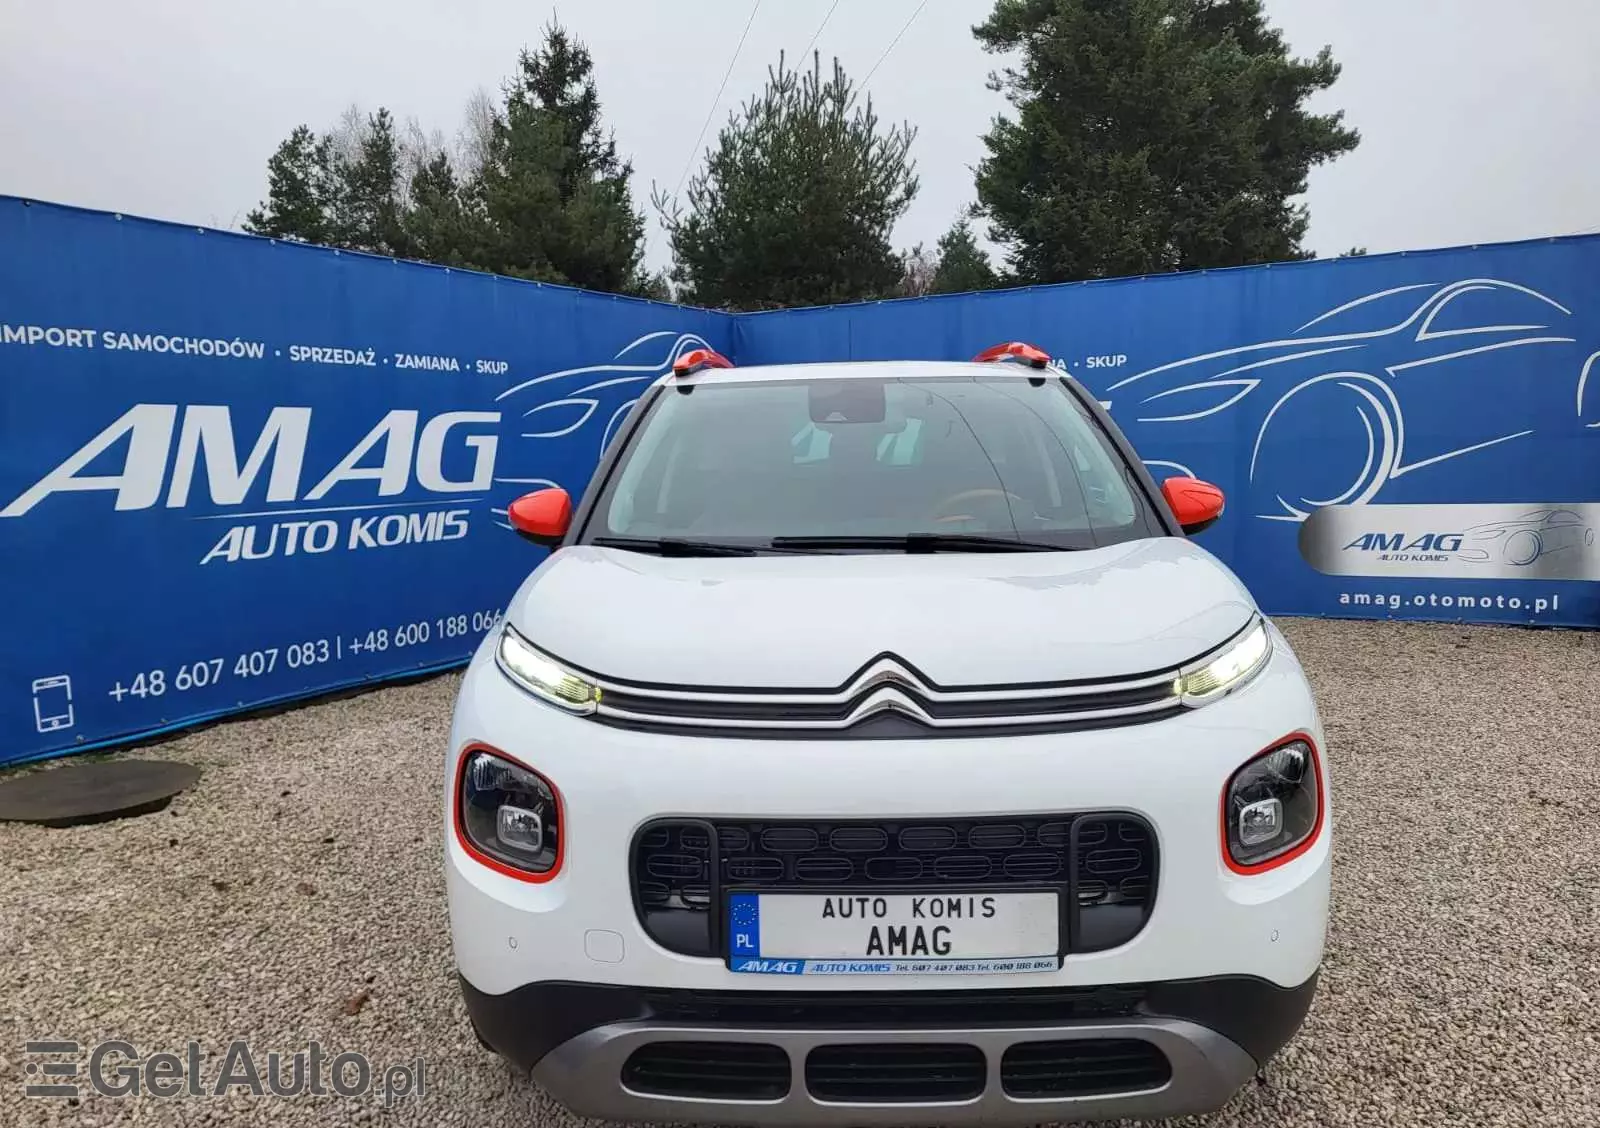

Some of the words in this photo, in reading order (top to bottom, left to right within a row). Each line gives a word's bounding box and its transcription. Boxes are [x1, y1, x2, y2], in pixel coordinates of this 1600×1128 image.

[103, 331, 265, 359] SAMOCHODÓW
[289, 345, 377, 367] SPRZEDAŻ
[395, 354, 461, 373] ZAMIANA
[476, 360, 508, 374] SKUP
[1086, 354, 1127, 369] SKUP
[200, 518, 338, 565] AUTO
[348, 509, 470, 550] KOMIS
[1341, 533, 1464, 552] AMAG
[1339, 592, 1559, 613] amag.otomoto.pl
[109, 670, 166, 702] +48
[175, 658, 224, 691] 607
[233, 648, 279, 678] 407
[287, 639, 330, 669] 083
[350, 628, 389, 656] +48
[394, 622, 430, 647] 600
[436, 614, 468, 638] 188
[822, 897, 887, 919] AUTO
[912, 897, 996, 919] KOMIS
[736, 933, 754, 948] PL
[866, 925, 953, 956] AMAG
[738, 960, 798, 973] AMAG
[811, 963, 846, 973] AUTO
[848, 962, 892, 973] KOMIS
